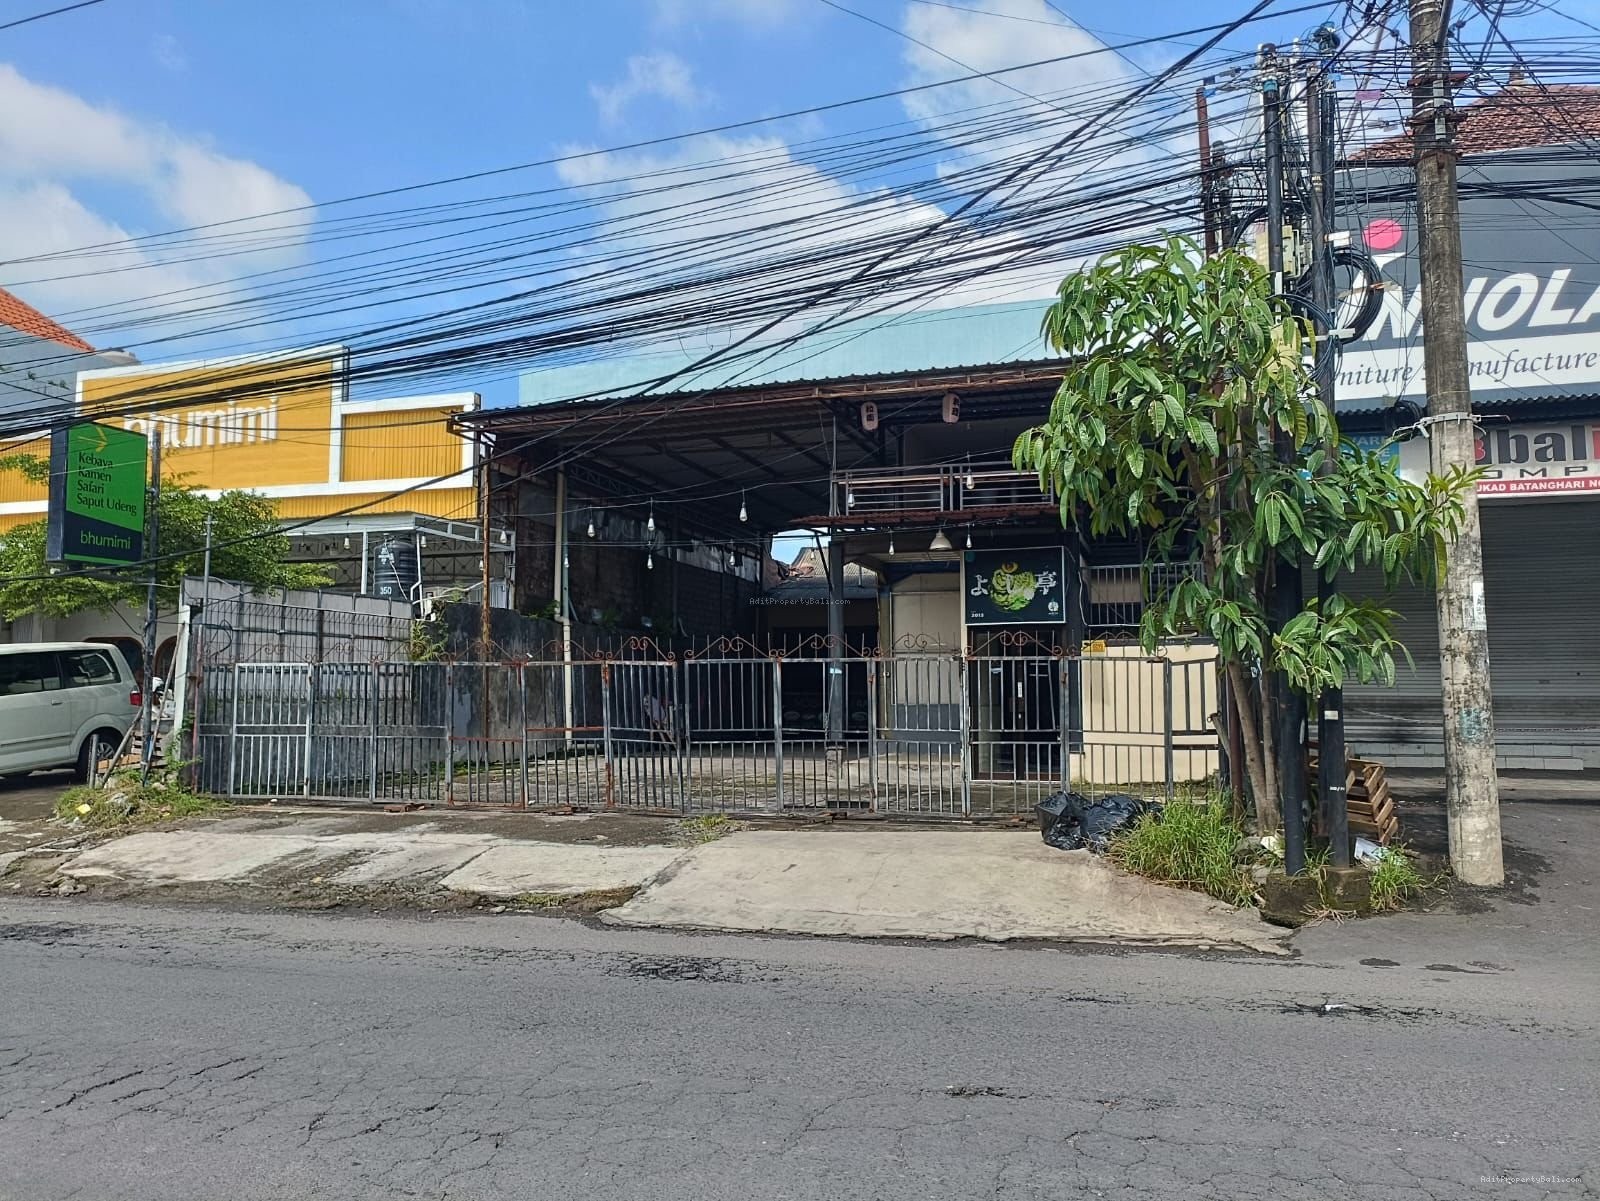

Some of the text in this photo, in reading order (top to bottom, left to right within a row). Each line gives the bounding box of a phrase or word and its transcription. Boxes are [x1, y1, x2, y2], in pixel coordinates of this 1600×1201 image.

[79, 451, 113, 470] Kebaya
[78, 465, 112, 482] Kamen
[77, 480, 105, 494] Safari
[1509, 480, 1585, 491] BATANGHARI
[77, 493, 137, 516] Saput Udeng
[80, 530, 131, 550] bhumimi
